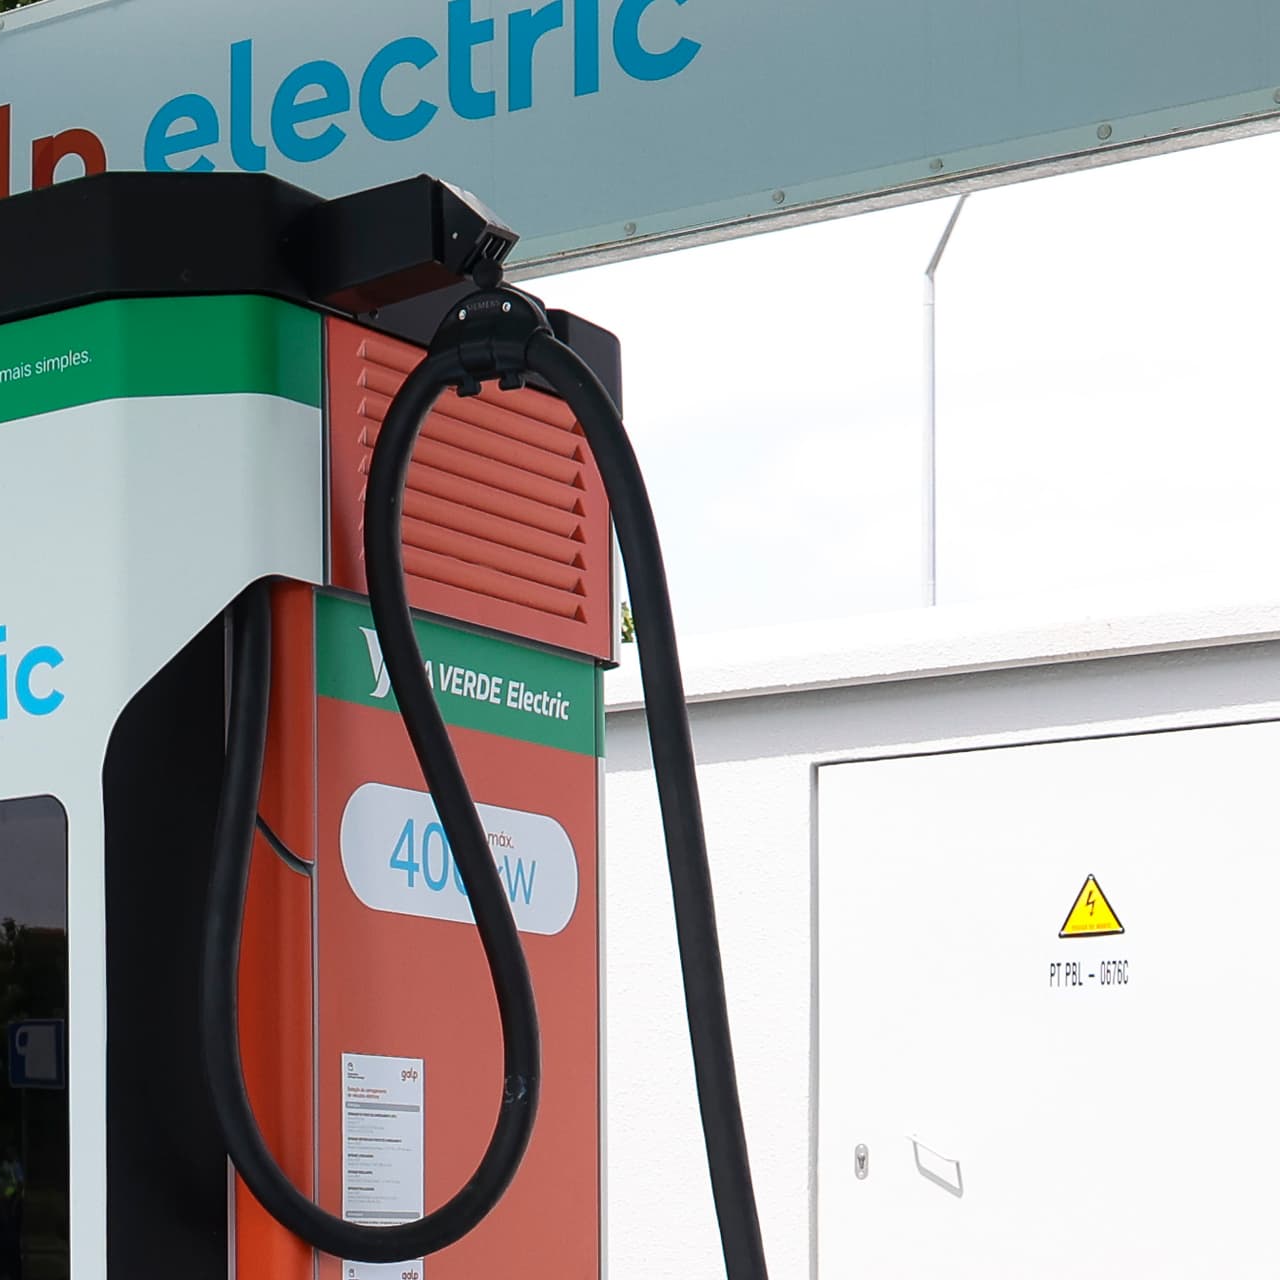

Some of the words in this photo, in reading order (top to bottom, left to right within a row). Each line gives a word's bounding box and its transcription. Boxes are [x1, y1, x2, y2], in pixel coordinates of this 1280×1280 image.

[143, 0, 703, 173] electric
[0, 363, 32, 384] mais
[35, 348, 93, 376] simples.
[439, 662, 502, 706] VERDE
[507, 681, 570, 721] Electric
[390, 818, 467, 897] 40
[497, 855, 536, 905] W
[1049, 962, 1061, 987] PT
[1065, 962, 1083, 987] PBL
